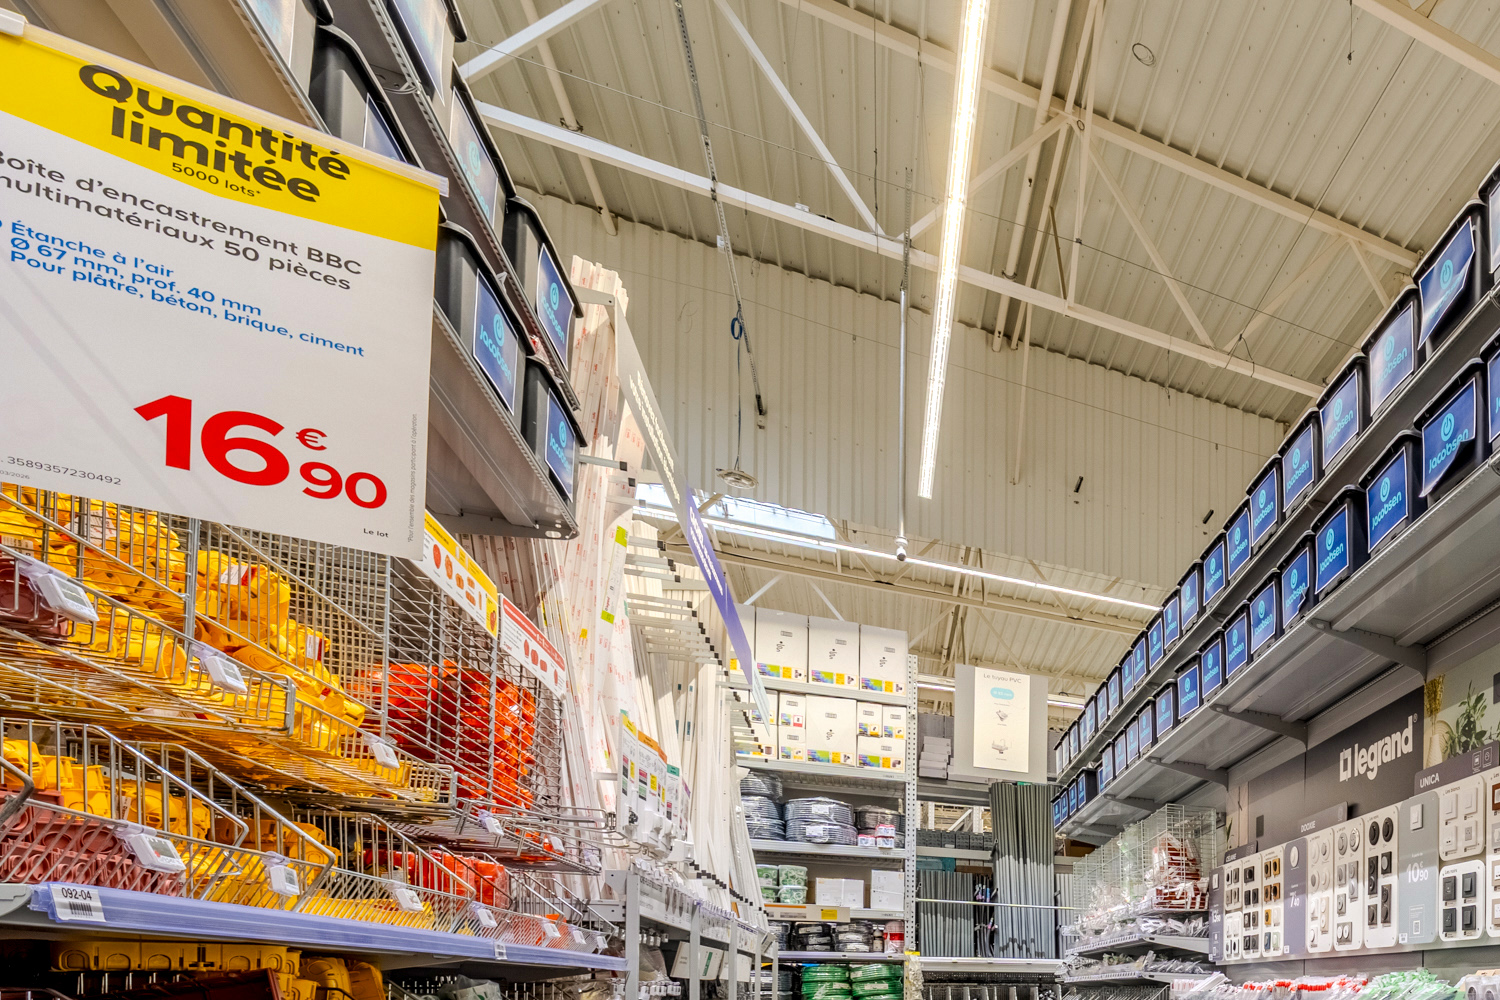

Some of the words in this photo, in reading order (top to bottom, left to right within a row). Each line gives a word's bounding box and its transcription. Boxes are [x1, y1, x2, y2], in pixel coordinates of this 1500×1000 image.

[79, 64, 350, 180] Quantité
[111, 106, 320, 202] limitée
[172, 162, 219, 185] 5000
[11, 220, 106, 258] Étanche
[113, 251, 126, 265] à
[134, 257, 174, 278] l'air
[76, 178, 298, 256] d'encastrement
[307, 246, 362, 275] BBC
[10, 237, 30, 251] Ø
[37, 245, 67, 260] 67
[74, 256, 124, 279] mm,
[132, 272, 180, 293] prof.
[187, 287, 215, 303] 40
[221, 298, 261, 316] mm
[224, 240, 259, 262] 50
[269, 256, 351, 290] pièces
[10, 251, 65, 275] Pour
[73, 268, 143, 298] plâtre,
[151, 289, 217, 319] béton,
[224, 310, 293, 339] brique,
[299, 332, 364, 357] ciment
[133, 395, 290, 486] 16
[295, 428, 328, 451] €
[7, 456, 122, 485] 3589357230492
[300, 462, 388, 509] 90
[363, 528, 376, 536] Le
[378, 530, 389, 539] lot
[1354, 715, 1413, 781] legrand
[1420, 772, 1440, 788] UNICA
[61, 887, 92, 900] 092-04
